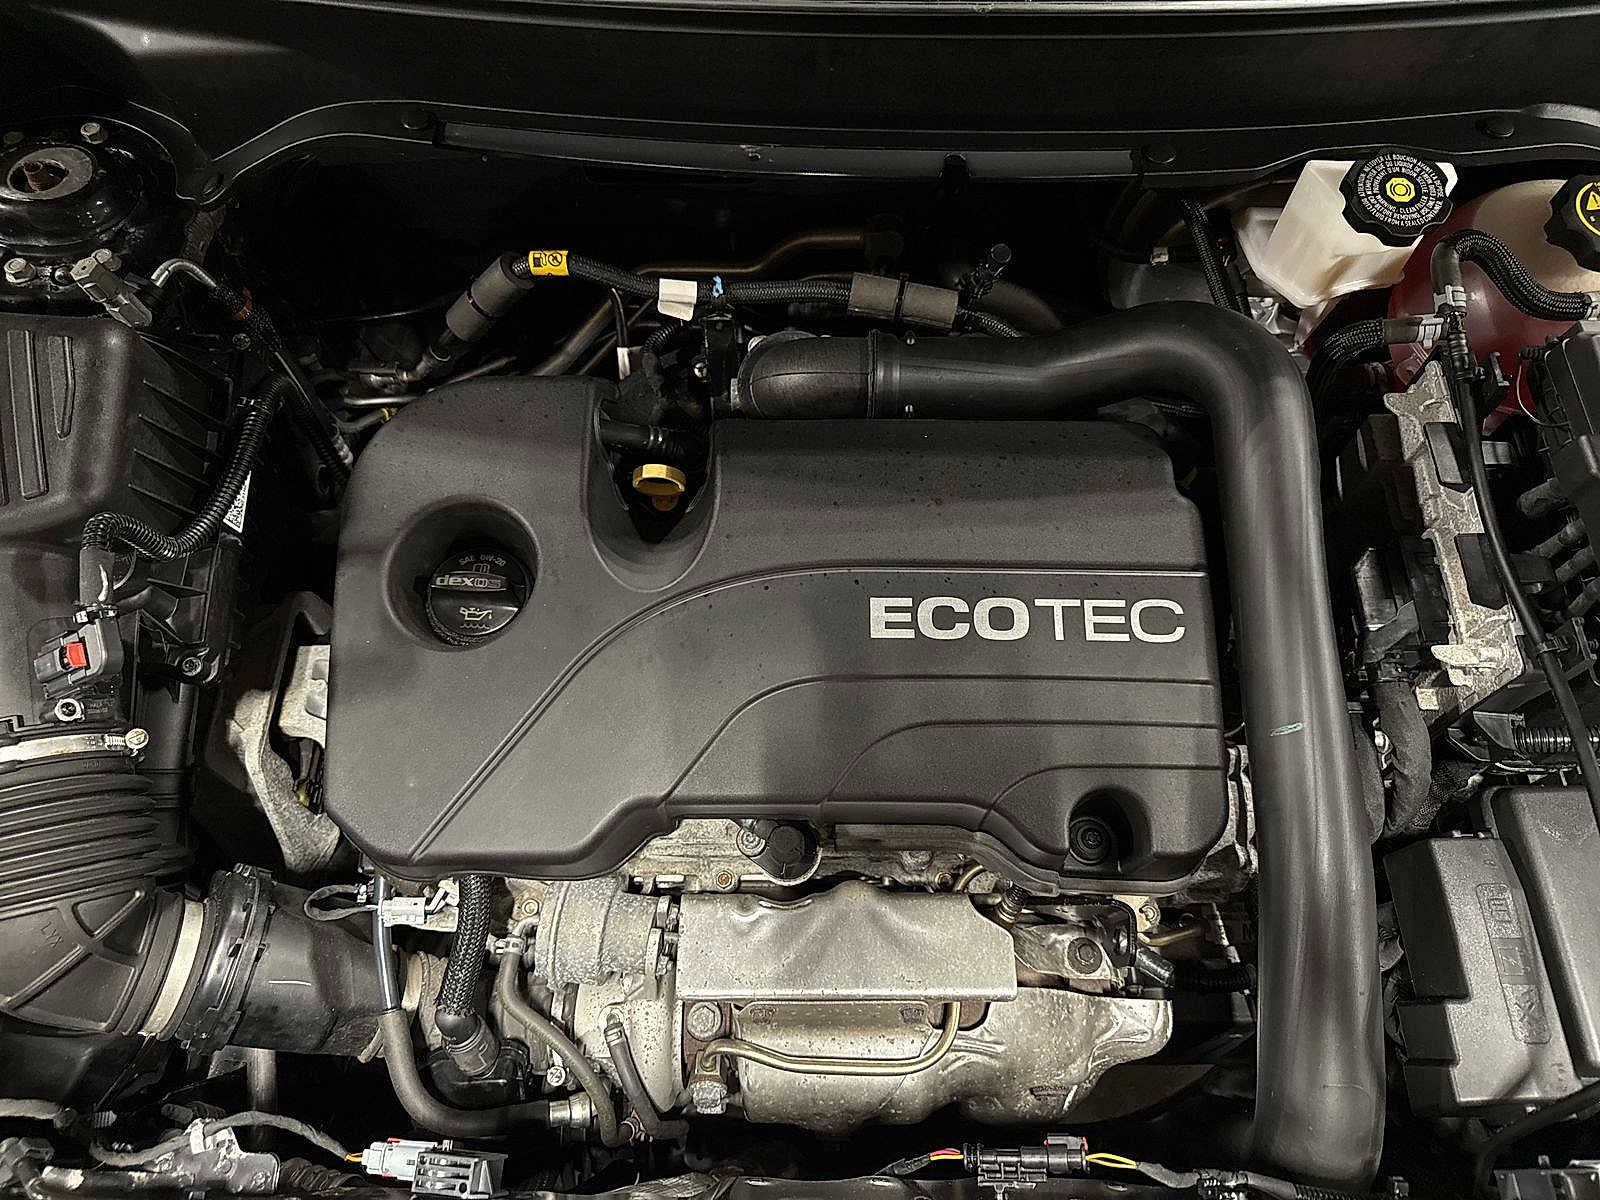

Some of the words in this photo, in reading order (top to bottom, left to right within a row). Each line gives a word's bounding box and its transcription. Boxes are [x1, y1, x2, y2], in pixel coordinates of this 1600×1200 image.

[1375, 162, 1386, 172] QUE
[1393, 160, 1414, 169] LIQUIDE
[1420, 171, 1433, 184] FREIN
[1384, 153, 1392, 161] LE
[1392, 153, 1418, 164] BOUCHON
[1417, 161, 1433, 174] AVANT
[1430, 172, 1438, 180] LA
[1368, 195, 1377, 205] CAP
[1374, 203, 1393, 217] BEFORE
[1420, 206, 1430, 215] USE
[1426, 197, 1436, 209] ONLY
[1400, 206, 1417, 214] CLEAN
[1415, 195, 1428, 210] FILLER
[1370, 208, 1385, 220] FLUID
[1384, 217, 1400, 226] FROM
[1404, 218, 1425, 227] SEALED
[869, 596, 1186, 643] ECOTEC
